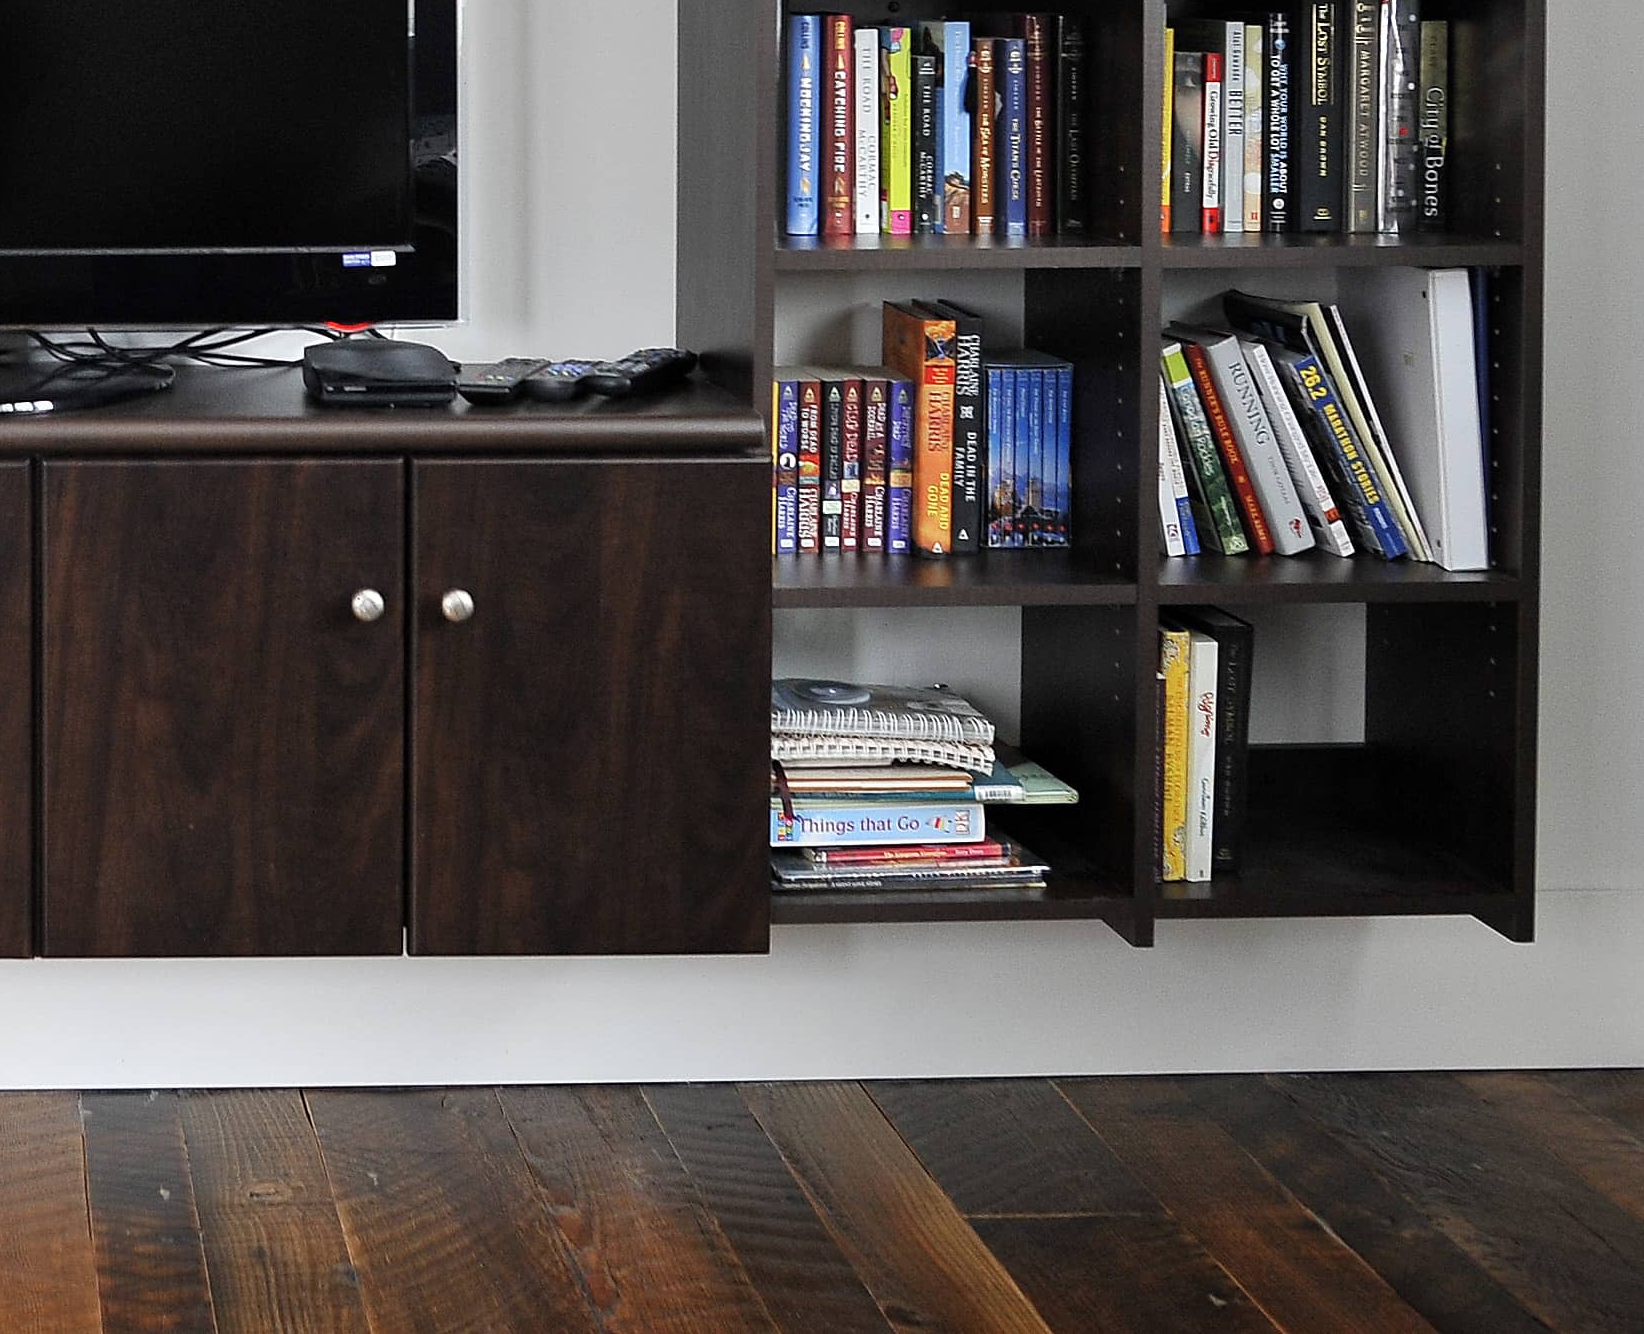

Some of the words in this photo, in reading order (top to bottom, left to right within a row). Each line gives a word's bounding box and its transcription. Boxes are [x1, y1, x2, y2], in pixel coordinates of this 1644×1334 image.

[1317, 22, 1330, 52] LOST
[863, 48, 871, 71] THE
[1270, 54, 1279, 65] TO
[1279, 64, 1288, 85] WHY
[1270, 67, 1279, 88] GET
[1360, 51, 1371, 117] MARGARET
[834, 71, 846, 137] CATCHING
[862, 78, 871, 113] ROAD
[922, 85, 931, 104] THE
[1207, 90, 1218, 128] Growing
[1280, 88, 1288, 113] YOUR
[1422, 87, 1445, 129] City
[799, 77, 811, 171] MOCKINGJAY
[922, 108, 931, 137] ROAD
[1228, 90, 1242, 135] BETTER
[1270, 100, 1279, 132] WHOLE
[1320, 116, 1328, 137] DAN
[1208, 129, 1219, 149] Old
[1270, 134, 1279, 151] LOT
[1280, 115, 1288, 148] WORLD
[1424, 134, 1442, 149] of
[834, 142, 845, 173] FIRE
[868, 135, 876, 190] CORMAC
[1319, 141, 1328, 177] BROWN
[1359, 124, 1370, 176] ATWOOD
[925, 156, 933, 194] CORMAC
[1270, 153, 1279, 193] SMALLER
[1424, 155, 1444, 217] Bones
[956, 335, 969, 396] HARRIS
[809, 404, 818, 430] FROM
[1227, 362, 1270, 446] RUNNING
[927, 391, 941, 452] HARRIS
[1298, 365, 1328, 401] 26.2
[1323, 403, 1359, 460] MARATHON
[1350, 462, 1380, 505] STORIES
[809, 432, 818, 453] DEAD
[966, 432, 977, 463] DEAD
[954, 447, 965, 487] FAMILY
[966, 465, 976, 477] IN
[926, 485, 938, 517] GONE
[939, 473, 949, 503] DEAD
[965, 481, 976, 502] THE
[938, 506, 948, 530] AND
[797, 815, 855, 836] Things
[859, 814, 893, 832] that
[897, 815, 920, 831] Go
